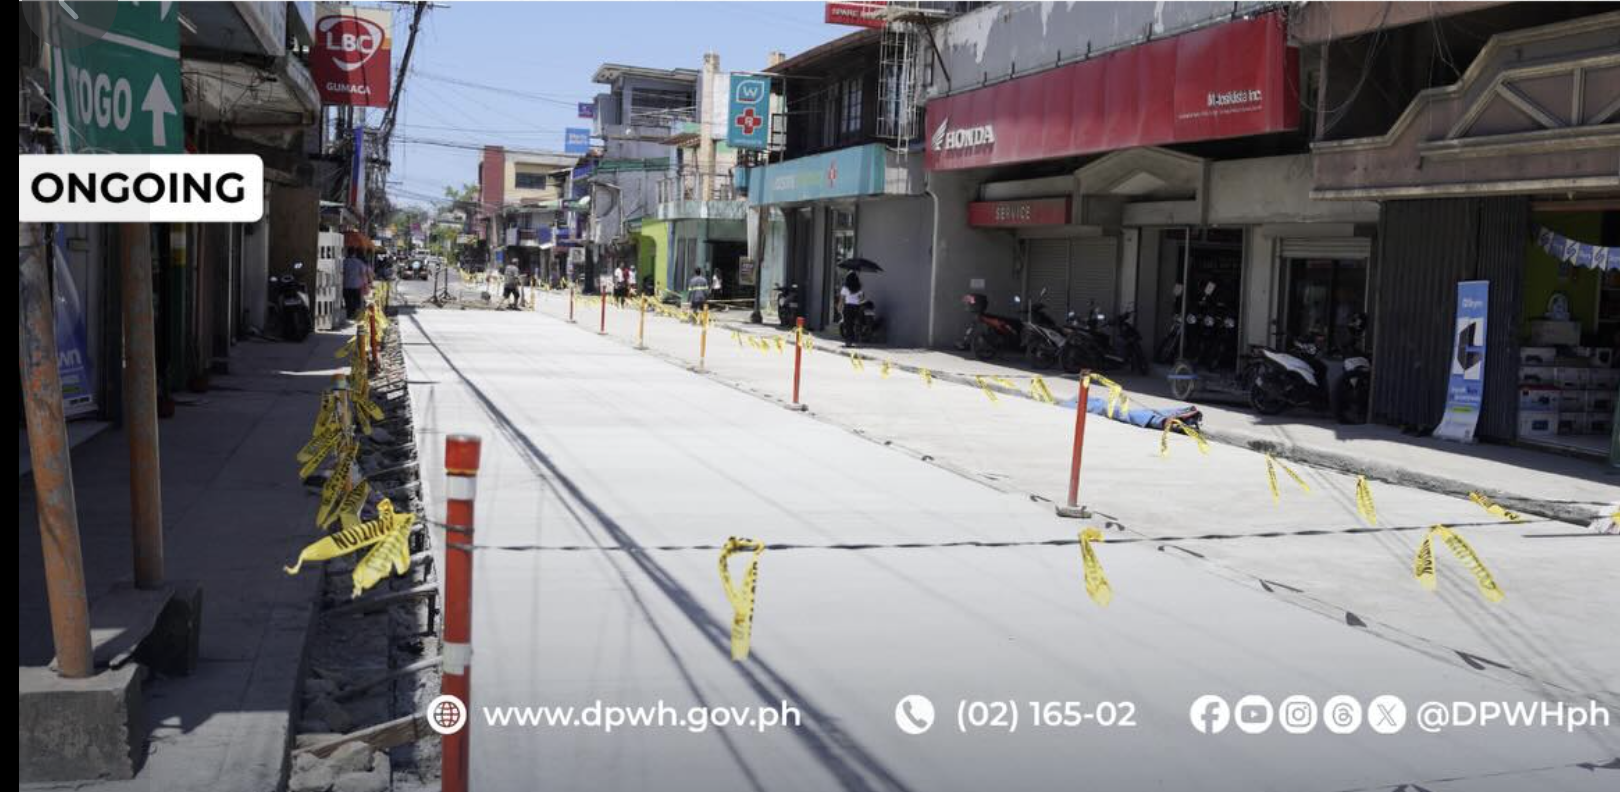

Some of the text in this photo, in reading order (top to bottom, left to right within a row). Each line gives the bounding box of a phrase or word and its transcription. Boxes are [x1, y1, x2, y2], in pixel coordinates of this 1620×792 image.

[326, 31, 373, 54] LBC
[326, 81, 372, 95] GUMACA
[944, 124, 996, 150] HONDA
[996, 203, 1032, 221] SERVICE
